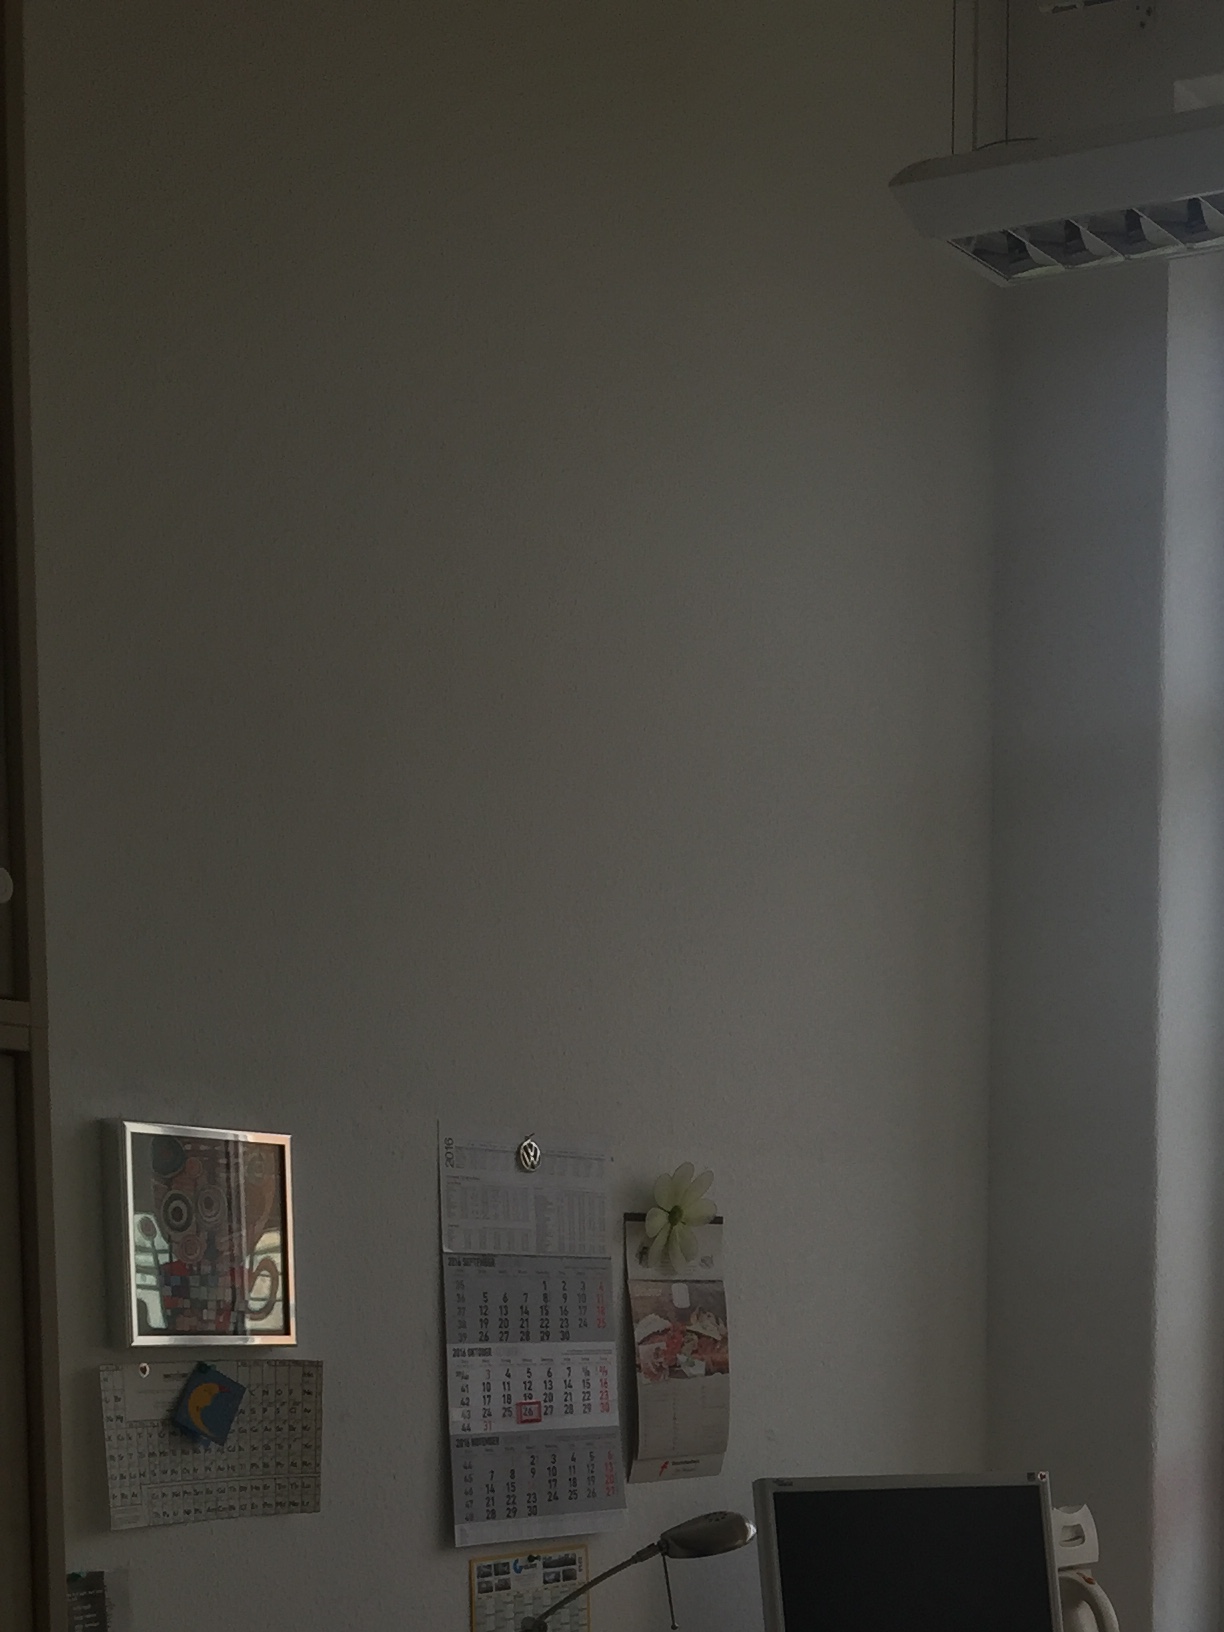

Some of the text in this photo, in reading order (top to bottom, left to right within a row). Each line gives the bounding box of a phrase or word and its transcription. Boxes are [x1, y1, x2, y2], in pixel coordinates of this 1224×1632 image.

[445, 1137, 455, 1168] 2016
[562, 1281, 567, 1291] 2
[483, 1292, 488, 1303] 5
[503, 1293, 508, 1303] 6
[523, 1293, 528, 1302] 7
[562, 1293, 567, 1303] 9
[479, 1305, 488, 1315] 12
[499, 1305, 508, 1316] 13
[520, 1305, 529, 1315] 14
[540, 1305, 549, 1316] 15
[560, 1306, 568, 1316] 16
[579, 1306, 587, 1315] 17
[479, 1319, 489, 1328] 19
[499, 1319, 509, 1328] 20
[520, 1319, 529, 1328] 21
[540, 1319, 549, 1328] 22
[560, 1319, 569, 1328] 23
[579, 1319, 587, 1328] 24
[479, 1331, 489, 1341] 26
[499, 1331, 509, 1341] 27
[520, 1331, 530, 1341] 28
[540, 1331, 550, 1341] 29
[560, 1331, 570, 1341] 30
[505, 1368, 511, 1378] 4
[526, 1368, 532, 1378] 5
[547, 1368, 552, 1377] 6
[567, 1367, 571, 1377] 7
[483, 1382, 491, 1392] 10
[503, 1381, 510, 1391] 11
[523, 1381, 532, 1391] 12
[544, 1380, 553, 1390] 13
[564, 1380, 572, 1389] 14
[582, 1379, 590, 1389] 15
[483, 1395, 491, 1405] 17
[503, 1395, 511, 1404] 18
[543, 1393, 553, 1403] 20
[564, 1392, 572, 1402] 21
[582, 1392, 591, 1401] 22
[483, 1408, 492, 1418] 24
[502, 1407, 512, 1417] 25
[523, 1406, 533, 1416] 26
[544, 1405, 553, 1415] 27
[564, 1404, 573, 1414] 28
[583, 1404, 591, 1414] 29
[530, 1455, 535, 1465] 2
[552, 1454, 556, 1464] 3
[571, 1452, 576, 1462] 4
[510, 1469, 515, 1479] 8
[531, 1468, 535, 1478] 9
[547, 1467, 557, 1477] 10
[569, 1466, 575, 1475] 11
[587, 1464, 594, 1473] 12
[486, 1484, 495, 1494] 14
[506, 1482, 515, 1492] 15
[548, 1479, 557, 1489] 17
[569, 1478, 577, 1487] 18
[587, 1476, 595, 1485] 19
[486, 1497, 495, 1507] 21
[506, 1494, 516, 1505] 22
[527, 1493, 537, 1503] 23
[547, 1491, 558, 1502] 24
[568, 1490, 578, 1500] 25
[587, 1488, 596, 1498] 26
[486, 1509, 496, 1520] 28
[506, 1507, 517, 1517] 29
[528, 1506, 537, 1516] 30
